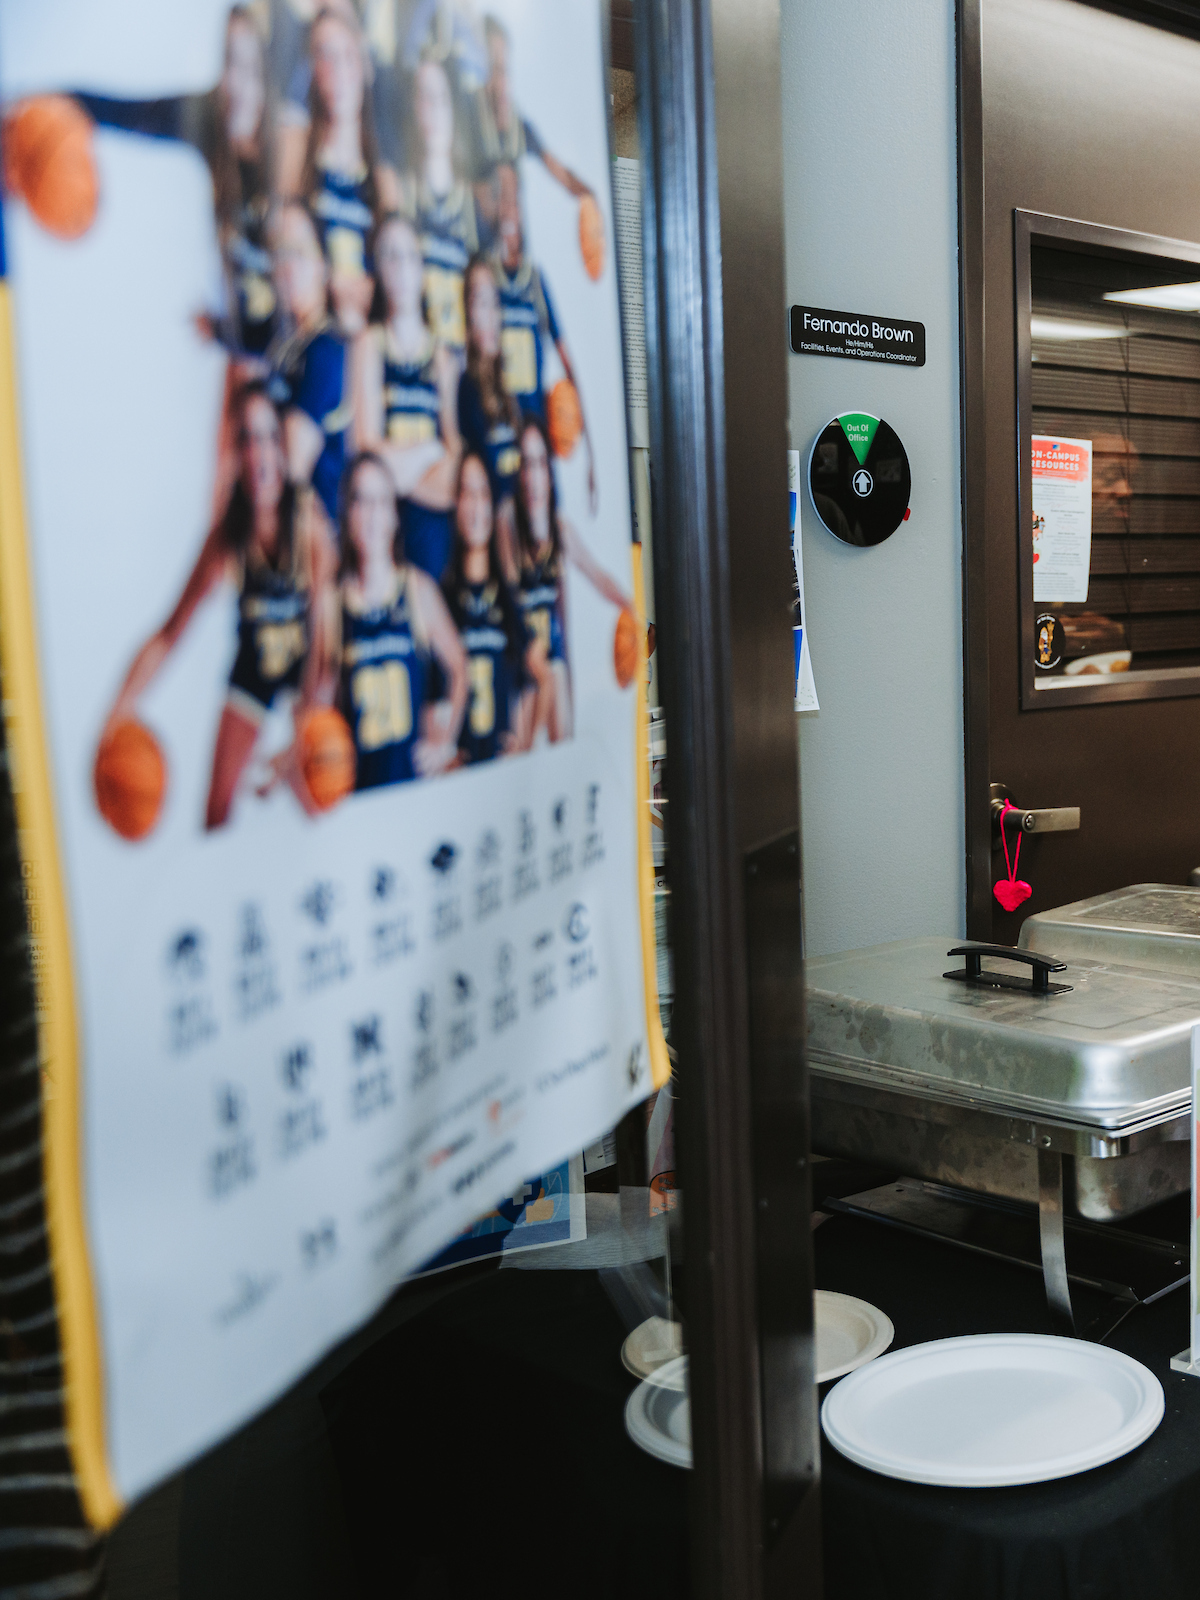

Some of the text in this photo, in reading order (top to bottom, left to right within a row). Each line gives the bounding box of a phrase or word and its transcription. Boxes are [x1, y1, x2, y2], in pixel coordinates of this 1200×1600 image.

[803, 312, 914, 343] Fernando Brown
[845, 348, 856, 356] and
[857, 348, 885, 359] Operations
[885, 352, 917, 362] Coordinator
[847, 424, 869, 432] Out Of
[848, 434, 869, 442] Office
